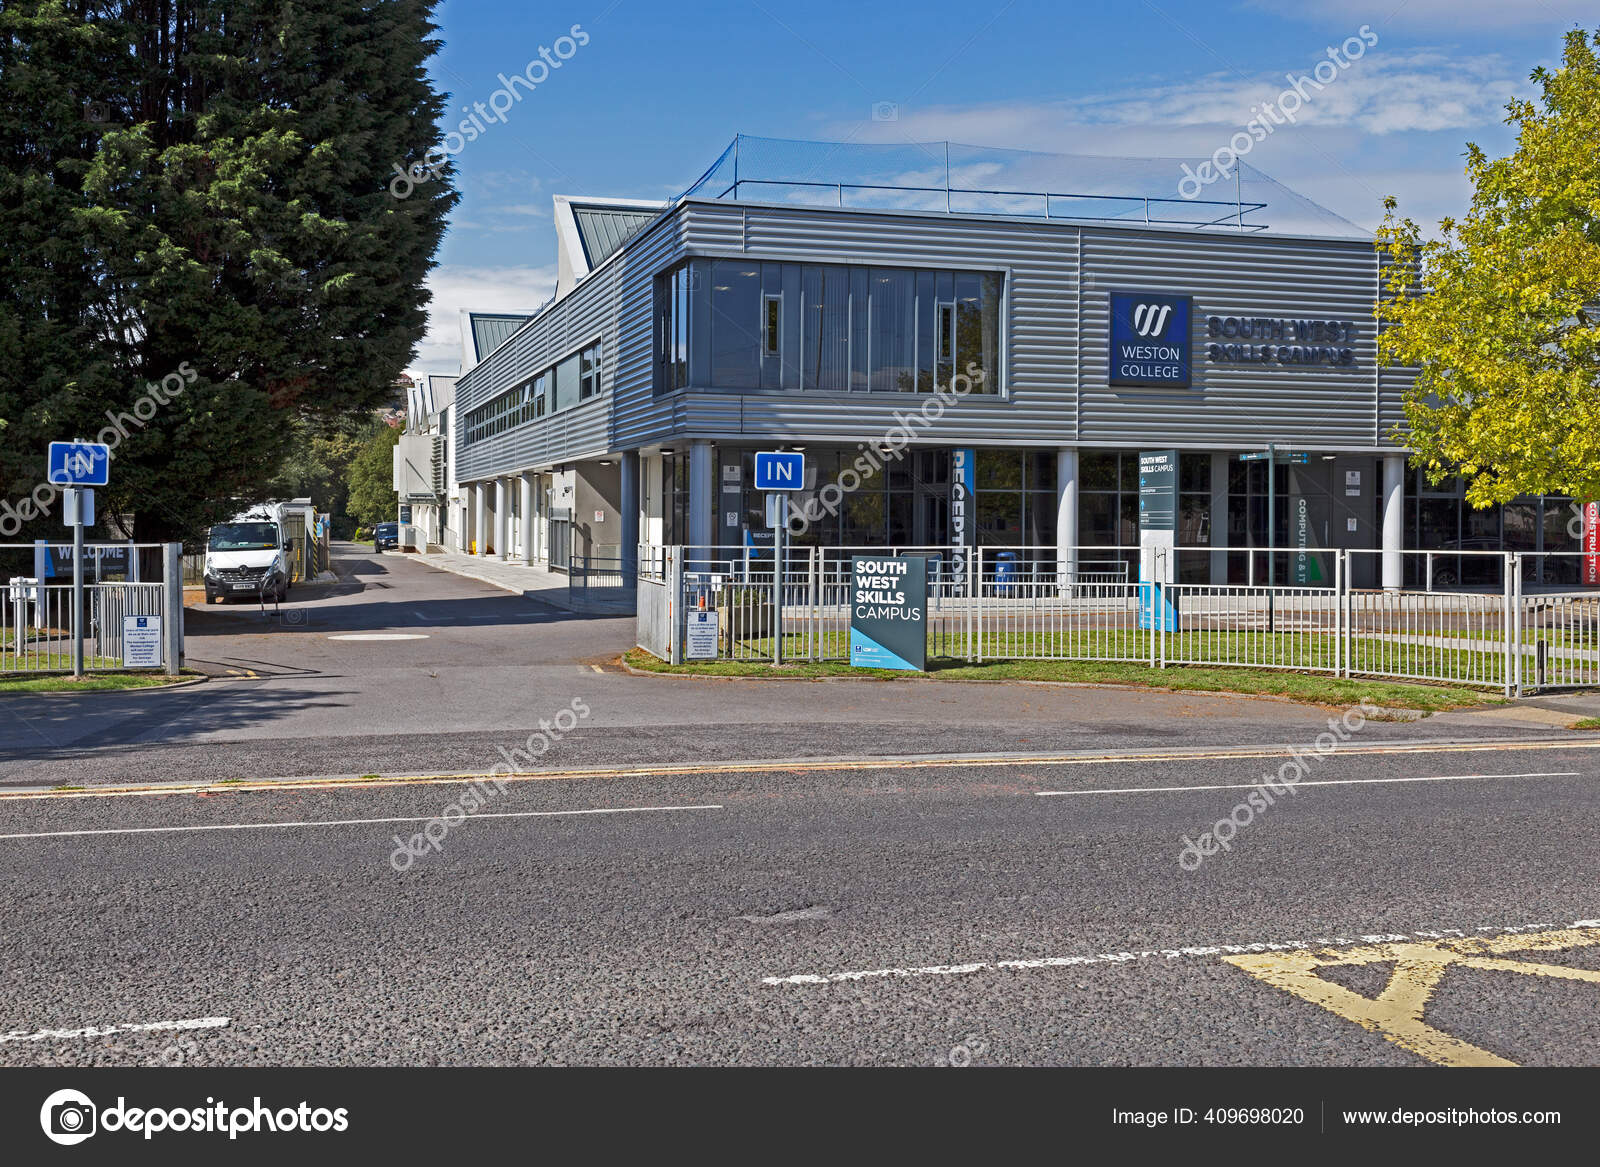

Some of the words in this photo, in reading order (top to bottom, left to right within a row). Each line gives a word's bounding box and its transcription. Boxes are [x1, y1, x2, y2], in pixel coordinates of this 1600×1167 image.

[1208, 316, 1284, 340] SOUTH
[1290, 319, 1354, 342] WEST
[1122, 345, 1180, 361] WESTON
[1208, 344, 1271, 363] SKILLS
[1277, 346, 1353, 365] CAMPUS
[1121, 364, 1179, 378] COLLEGE
[64, 453, 95, 475] IN
[767, 461, 793, 481] IN
[1140, 465, 1154, 473] SKILLS
[1155, 464, 1174, 472] CAMPUS
[952, 451, 965, 593] RECEPTION
[1589, 502, 1597, 582] CONSTRUCTION
[58, 546, 124, 560] WCOME
[856, 560, 907, 575] SOUTH
[856, 575, 900, 589] WEST
[1298, 574, 1306, 584] IT
[856, 591, 905, 605] SKILLS
[856, 606, 921, 621] CAMPUS
